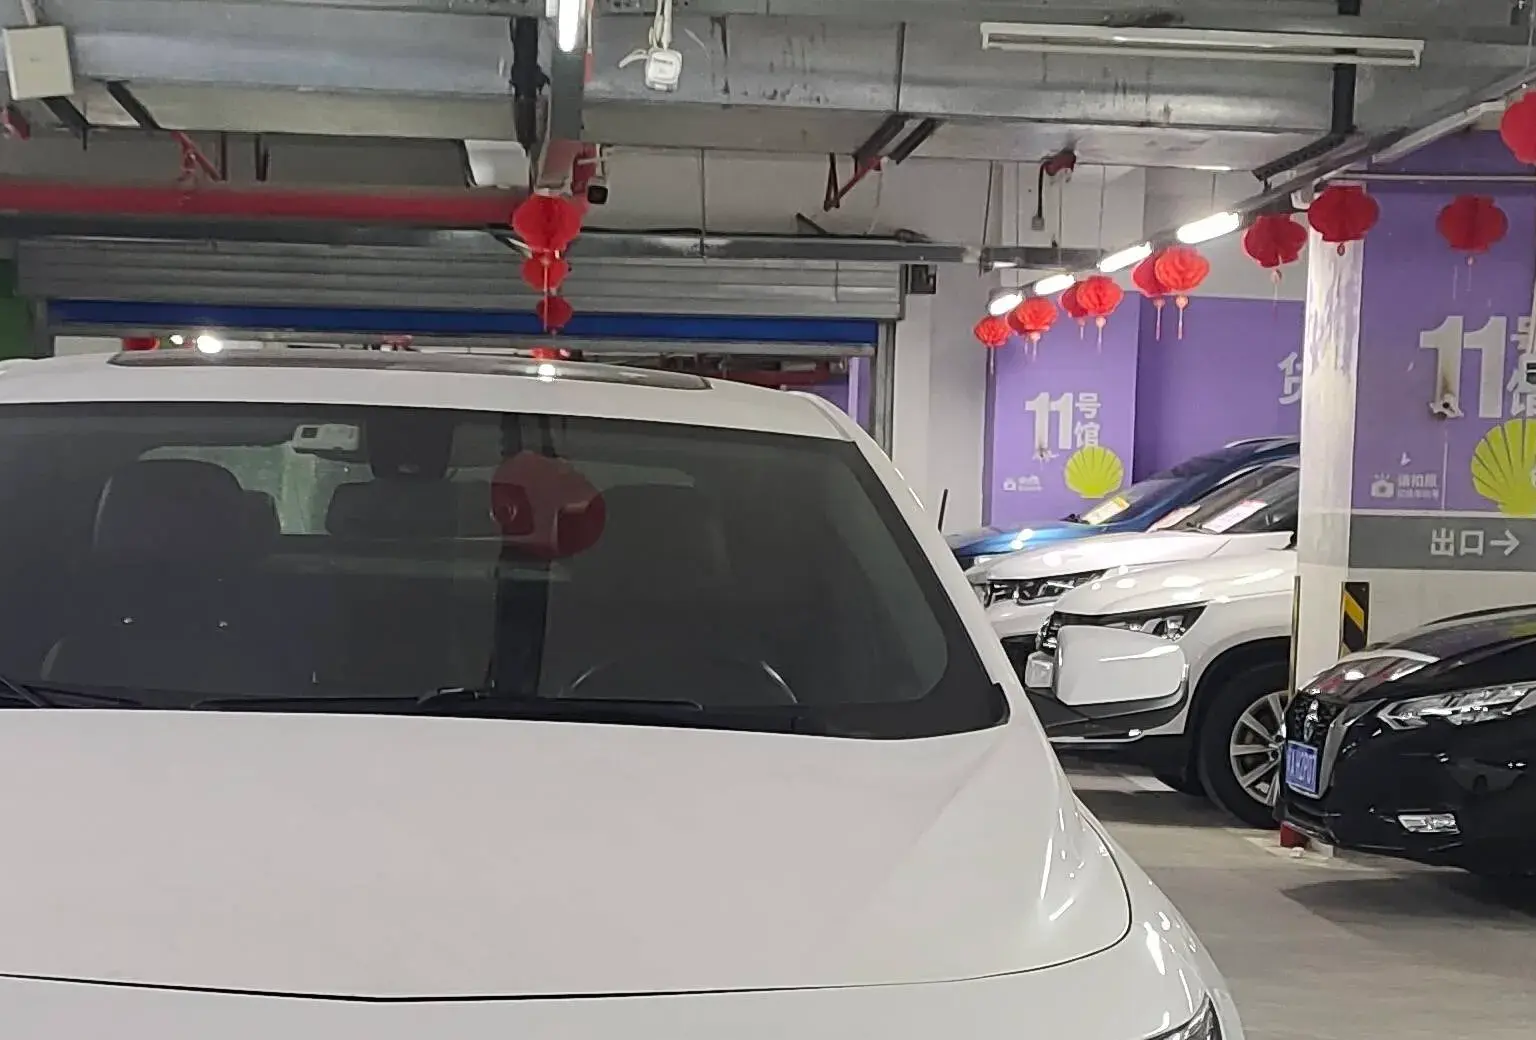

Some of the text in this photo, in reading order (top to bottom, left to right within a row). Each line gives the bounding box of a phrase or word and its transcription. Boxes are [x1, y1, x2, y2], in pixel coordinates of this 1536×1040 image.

[1419, 315, 1507, 418] 11
[1024, 392, 1074, 451] 11
[1430, 527, 1485, 556] 出口
